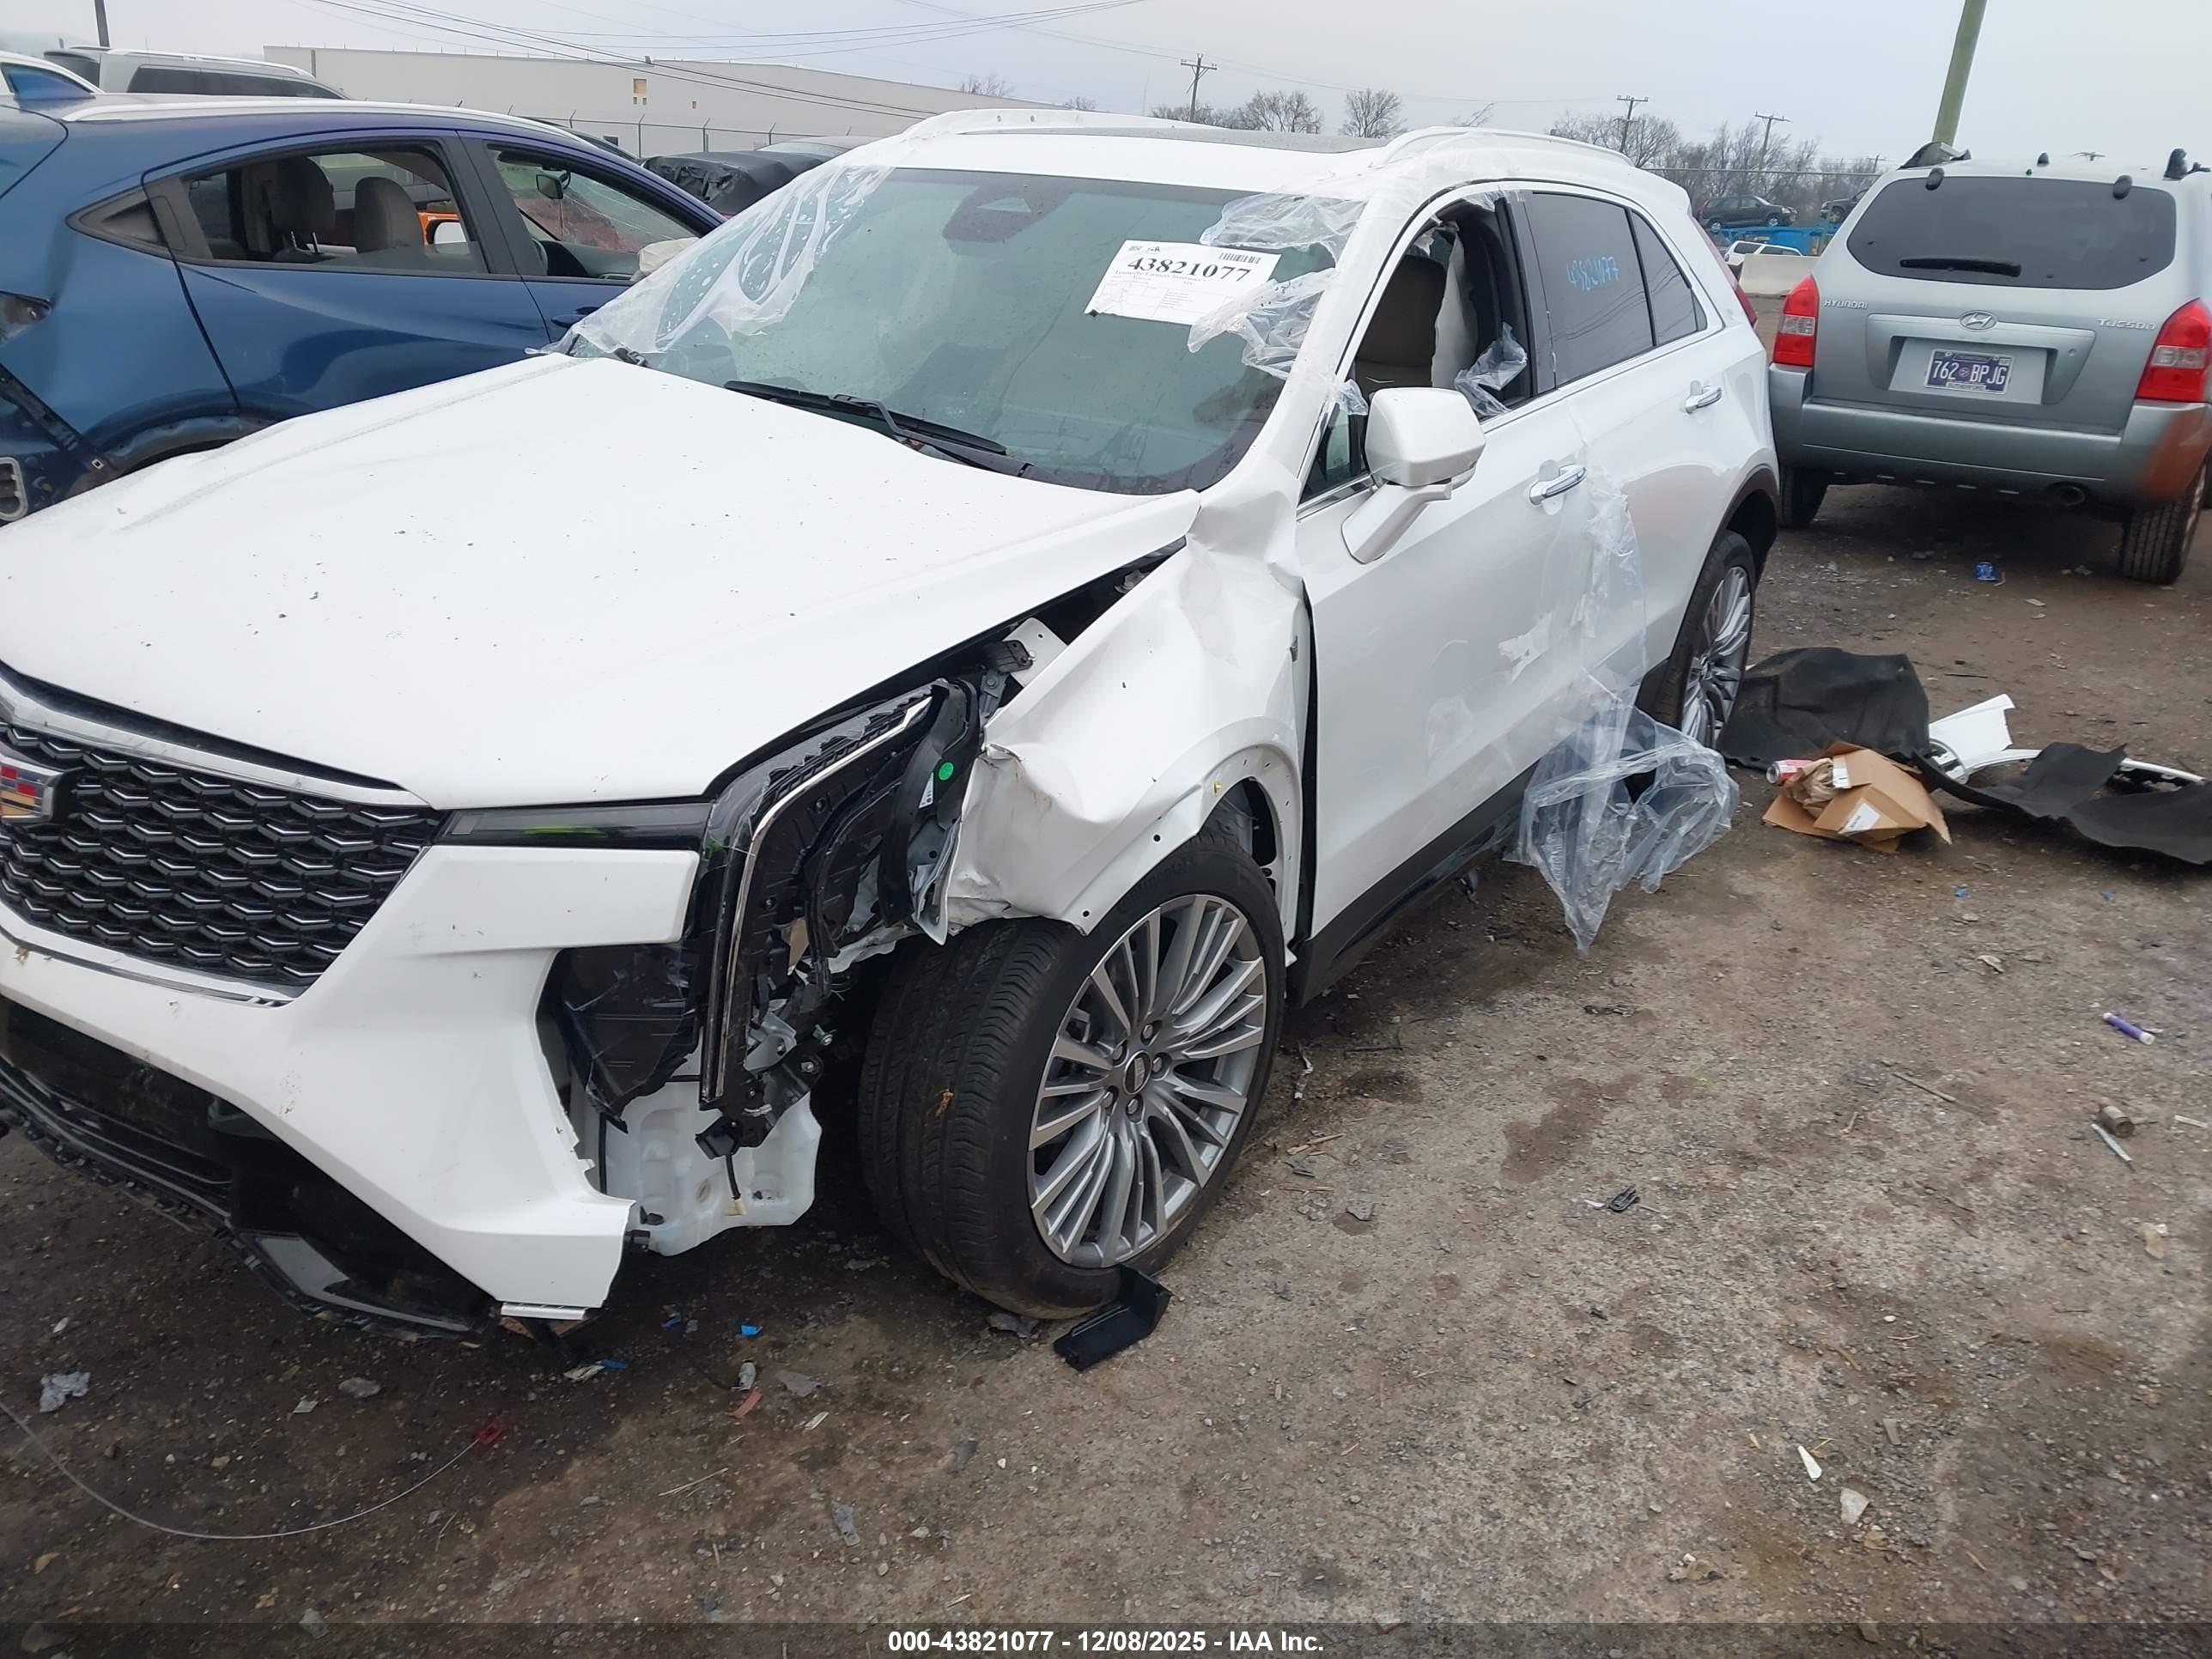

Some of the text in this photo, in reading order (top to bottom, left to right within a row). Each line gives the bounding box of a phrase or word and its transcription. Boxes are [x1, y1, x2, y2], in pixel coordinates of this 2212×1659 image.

[1127, 257, 1251, 282] 43821077
[1823, 298, 1869, 310] HYUNDAI
[2097, 318, 2157, 331] TUCSON
[1933, 361, 2008, 385] 762 BPJG
